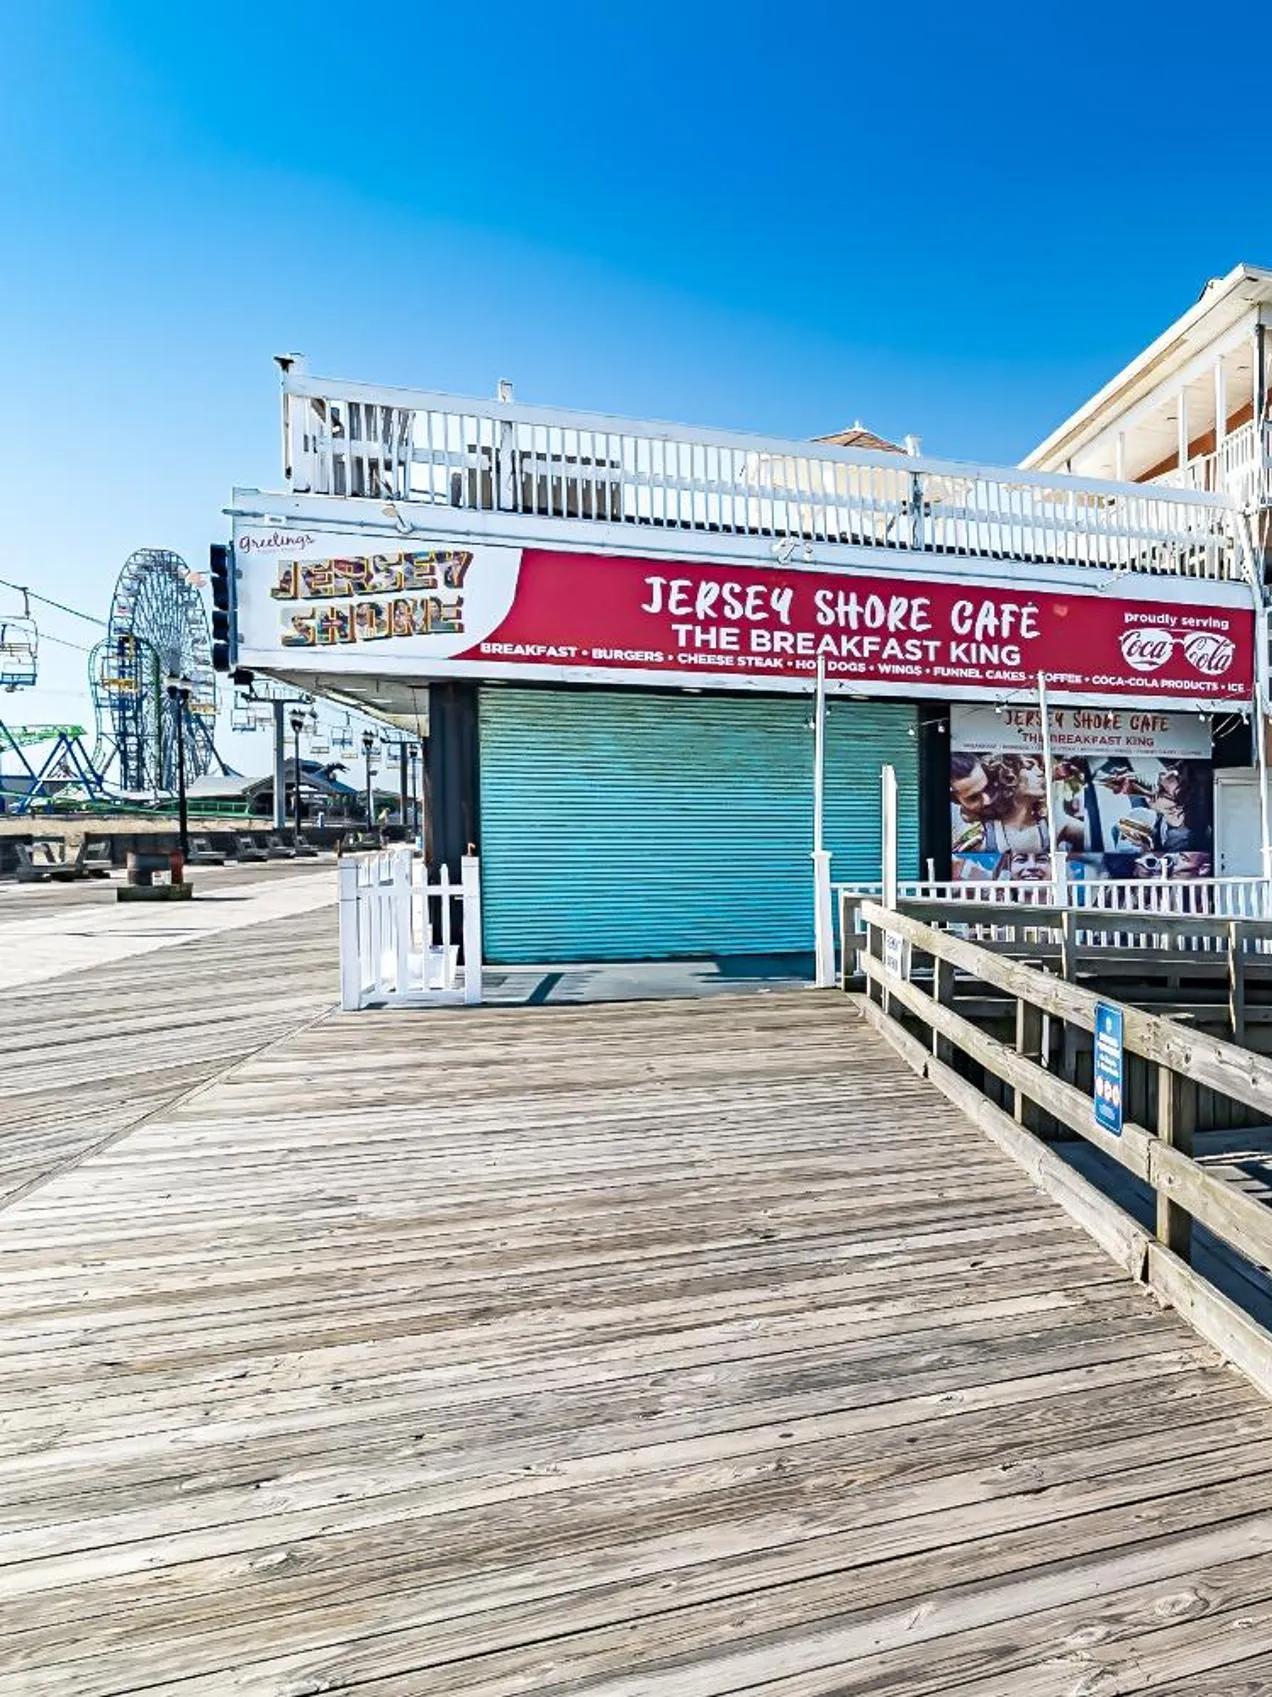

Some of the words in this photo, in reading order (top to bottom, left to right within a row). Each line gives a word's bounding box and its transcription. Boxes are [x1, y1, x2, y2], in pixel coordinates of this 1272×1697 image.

[271, 551, 474, 600] JERSEY
[281, 595, 465, 647] SHORE
[641, 576, 794, 626] JERSEY
[814, 589, 932, 633] SHORE
[950, 600, 1041, 642] CAFÉ
[1123, 612, 1177, 627] proudly
[1181, 616, 1229, 631] serving
[671, 623, 740, 651] THE
[751, 627, 942, 662] BREAKFAST
[950, 641, 1021, 666] KING
[1121, 631, 1173, 661] Coca
[1184, 636, 1235, 671] Cola
[480, 642, 578, 658] BREAKFAST
[591, 647, 665, 663] BURGERS
[677, 652, 735, 666] CHEESE
[736, 656, 784, 669] STEAK
[795, 659, 824, 670] HO
[827, 660, 866, 673] DOGS
[877, 663, 923, 676] WINGS
[933, 666, 980, 679] FUNNEL
[985, 669, 1027, 682] CAKES
[1091, 674, 1159, 688] COCA-COLA
[1160, 678, 1219, 692] PRODUCTS
[1227, 683, 1245, 693] ICE
[1073, 710, 1120, 729] SHORE
[1049, 735, 1121, 746] BREAKFAST
[1126, 737, 1154, 747] KING
